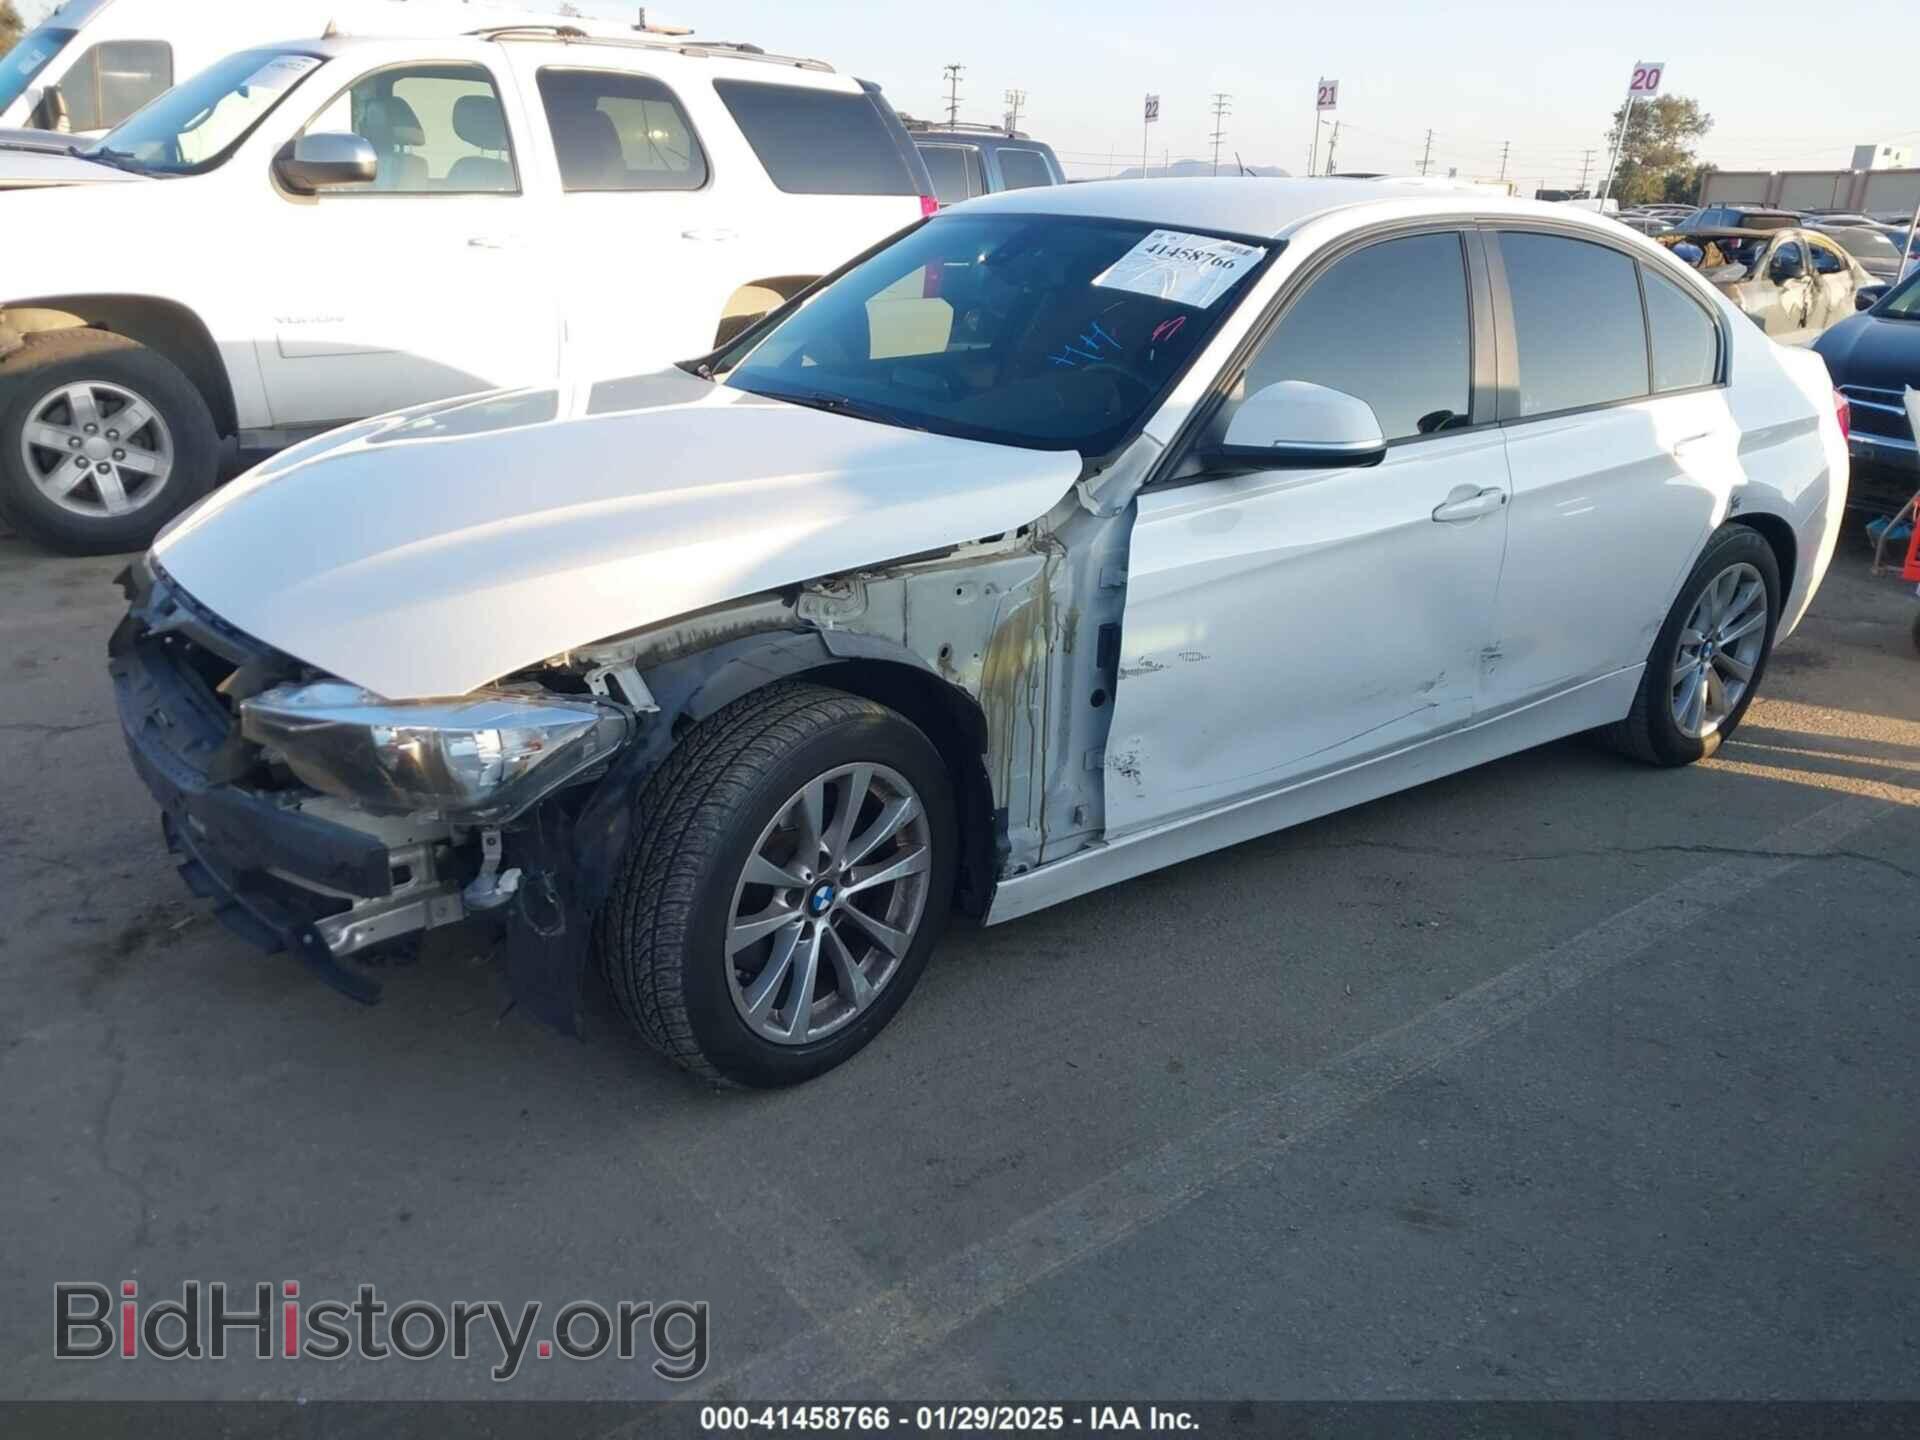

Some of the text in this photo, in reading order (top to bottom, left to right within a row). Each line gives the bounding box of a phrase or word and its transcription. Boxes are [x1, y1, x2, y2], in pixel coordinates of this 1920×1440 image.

[1631, 69, 1661, 89] 20
[1318, 86, 1336, 105] 21
[1145, 101, 1159, 118] 22
[1146, 243, 1235, 269] 41458766
